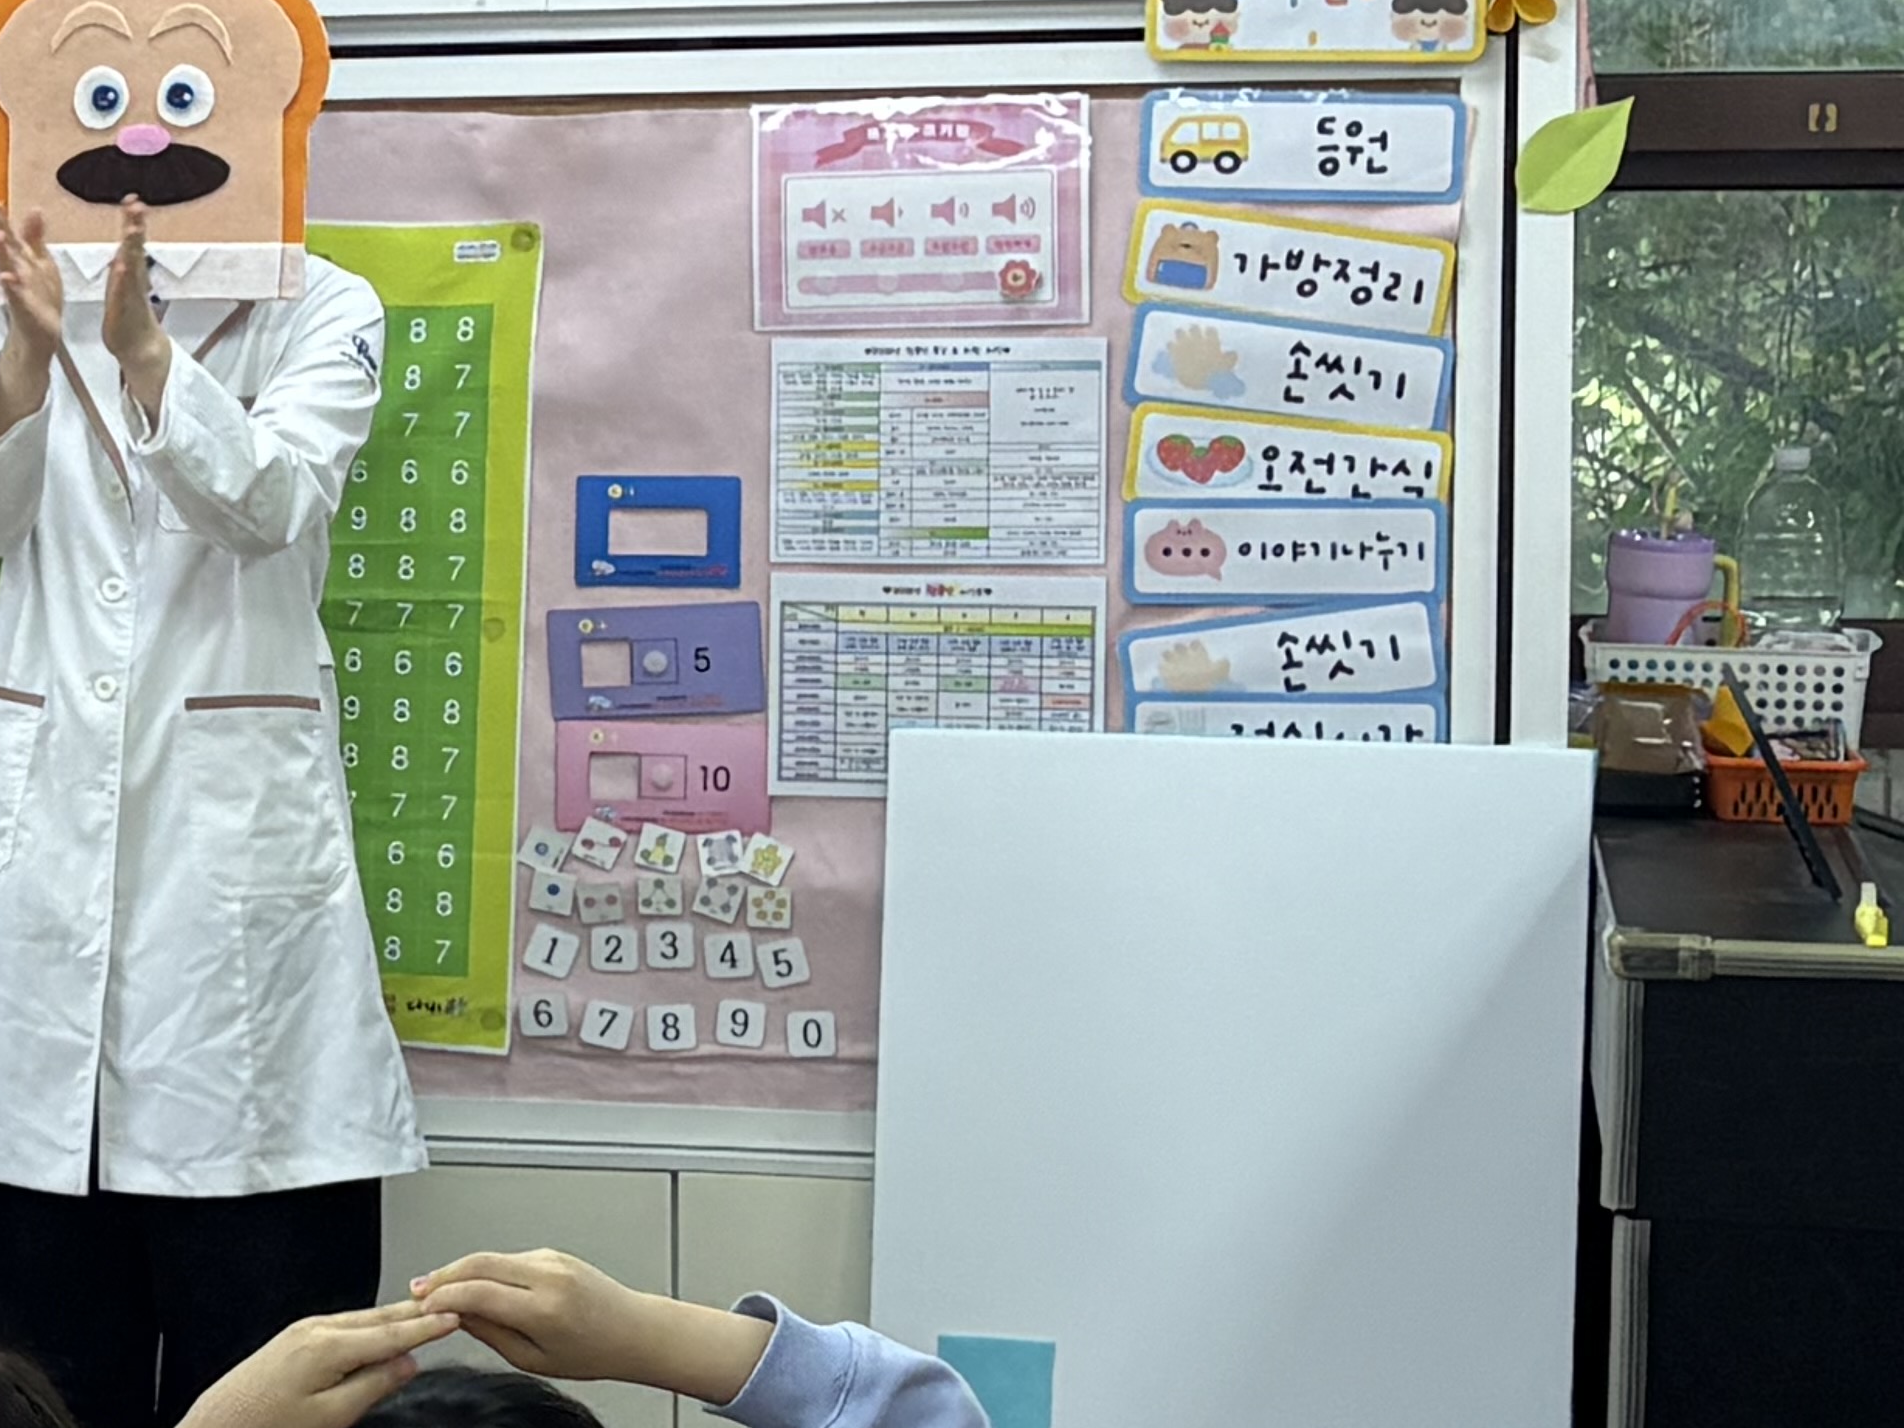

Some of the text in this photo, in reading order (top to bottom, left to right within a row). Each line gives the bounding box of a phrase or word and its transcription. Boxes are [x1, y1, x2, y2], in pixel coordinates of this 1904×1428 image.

[1315, 116, 1389, 176] 등원
[1233, 248, 1425, 307] 가방정리
[409, 316, 474, 343] 8 8
[404, 364, 472, 390] 8 7
[1283, 340, 1407, 404] 손씻기
[402, 412, 471, 437] 7 7
[352, 459, 468, 485] 6 6 6
[1257, 444, 1433, 500] 오전간식
[351, 506, 466, 533] 9 8 8
[1237, 531, 1426, 572] 이야기나누기
[348, 554, 465, 580] 8 8 7
[346, 601, 464, 629] 7 7 7
[345, 648, 462, 676] 6 6 6
[693, 646, 711, 673] 5
[1277, 630, 1400, 693] 손씻기
[343, 696, 460, 724] 9 8 8
[392, 745, 408, 770] 8
[442, 747, 459, 772] 7
[699, 765, 731, 793] 10
[390, 793, 458, 820] 7 7
[388, 841, 454, 868] 6 6
[387, 888, 452, 916] 8 8
[385, 936, 452, 964] 8 7
[542, 930, 793, 978] 1 2 3 4 5
[532, 998, 823, 1049] 6 7 8 9 0
